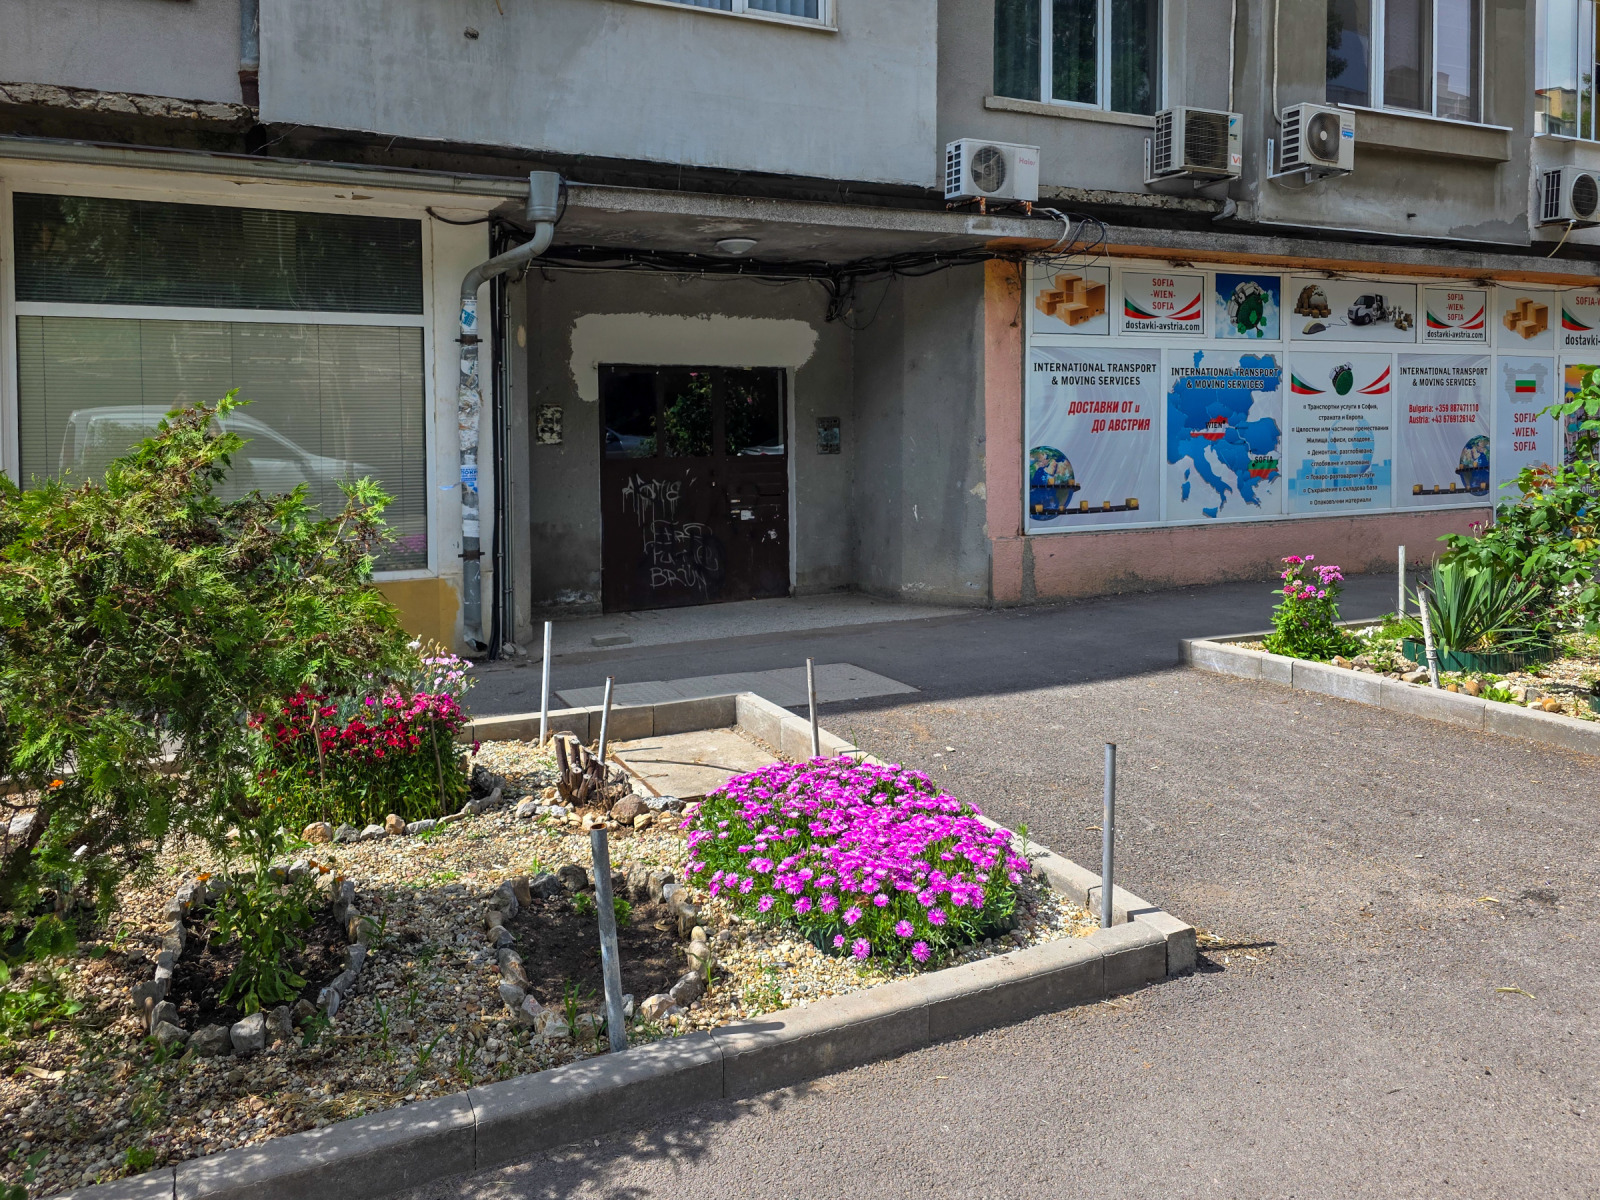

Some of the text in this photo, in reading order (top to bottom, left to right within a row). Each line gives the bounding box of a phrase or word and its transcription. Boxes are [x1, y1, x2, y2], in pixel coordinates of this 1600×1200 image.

[1152, 278, 1175, 288] SOFIA
[1150, 289, 1176, 299] -WIEN-
[1447, 293, 1464, 301] SOFIA
[1152, 301, 1175, 311] SOFIA
[1446, 303, 1466, 311] -WIEN-
[1447, 313, 1464, 321] SOFIA
[1125, 320, 1200, 332] dostavki-avstria.com
[1427, 330, 1484, 339] dostavki-avstria.com
[1033, 362, 1157, 373] INTERNATIONAL TRANSPORT
[1171, 367, 1279, 377] INTERNATIONAL TRANSPORT
[1399, 367, 1488, 376] INTERNATIONAL TRANSPORT
[1051, 376, 1141, 386] & MOVING SERVICES
[1186, 379, 1265, 389] & MOVING SERVICES
[1412, 378, 1477, 387] & MOVING SERVICES
[1067, 401, 1119, 416] ДОСТАВКИ
[1121, 401, 1134, 414] ОТ
[1408, 404, 1434, 414] Bulgaria:
[1408, 415, 1430, 424] Austria:
[1513, 412, 1537, 423] SOFIA
[1091, 418, 1151, 434] ДО АВСТРИЯ
[1205, 421, 1223, 429] WIEN
[1511, 427, 1539, 437] -WIEN-
[1513, 441, 1537, 452] SOFIA
[1254, 455, 1274, 463] SOFIA
